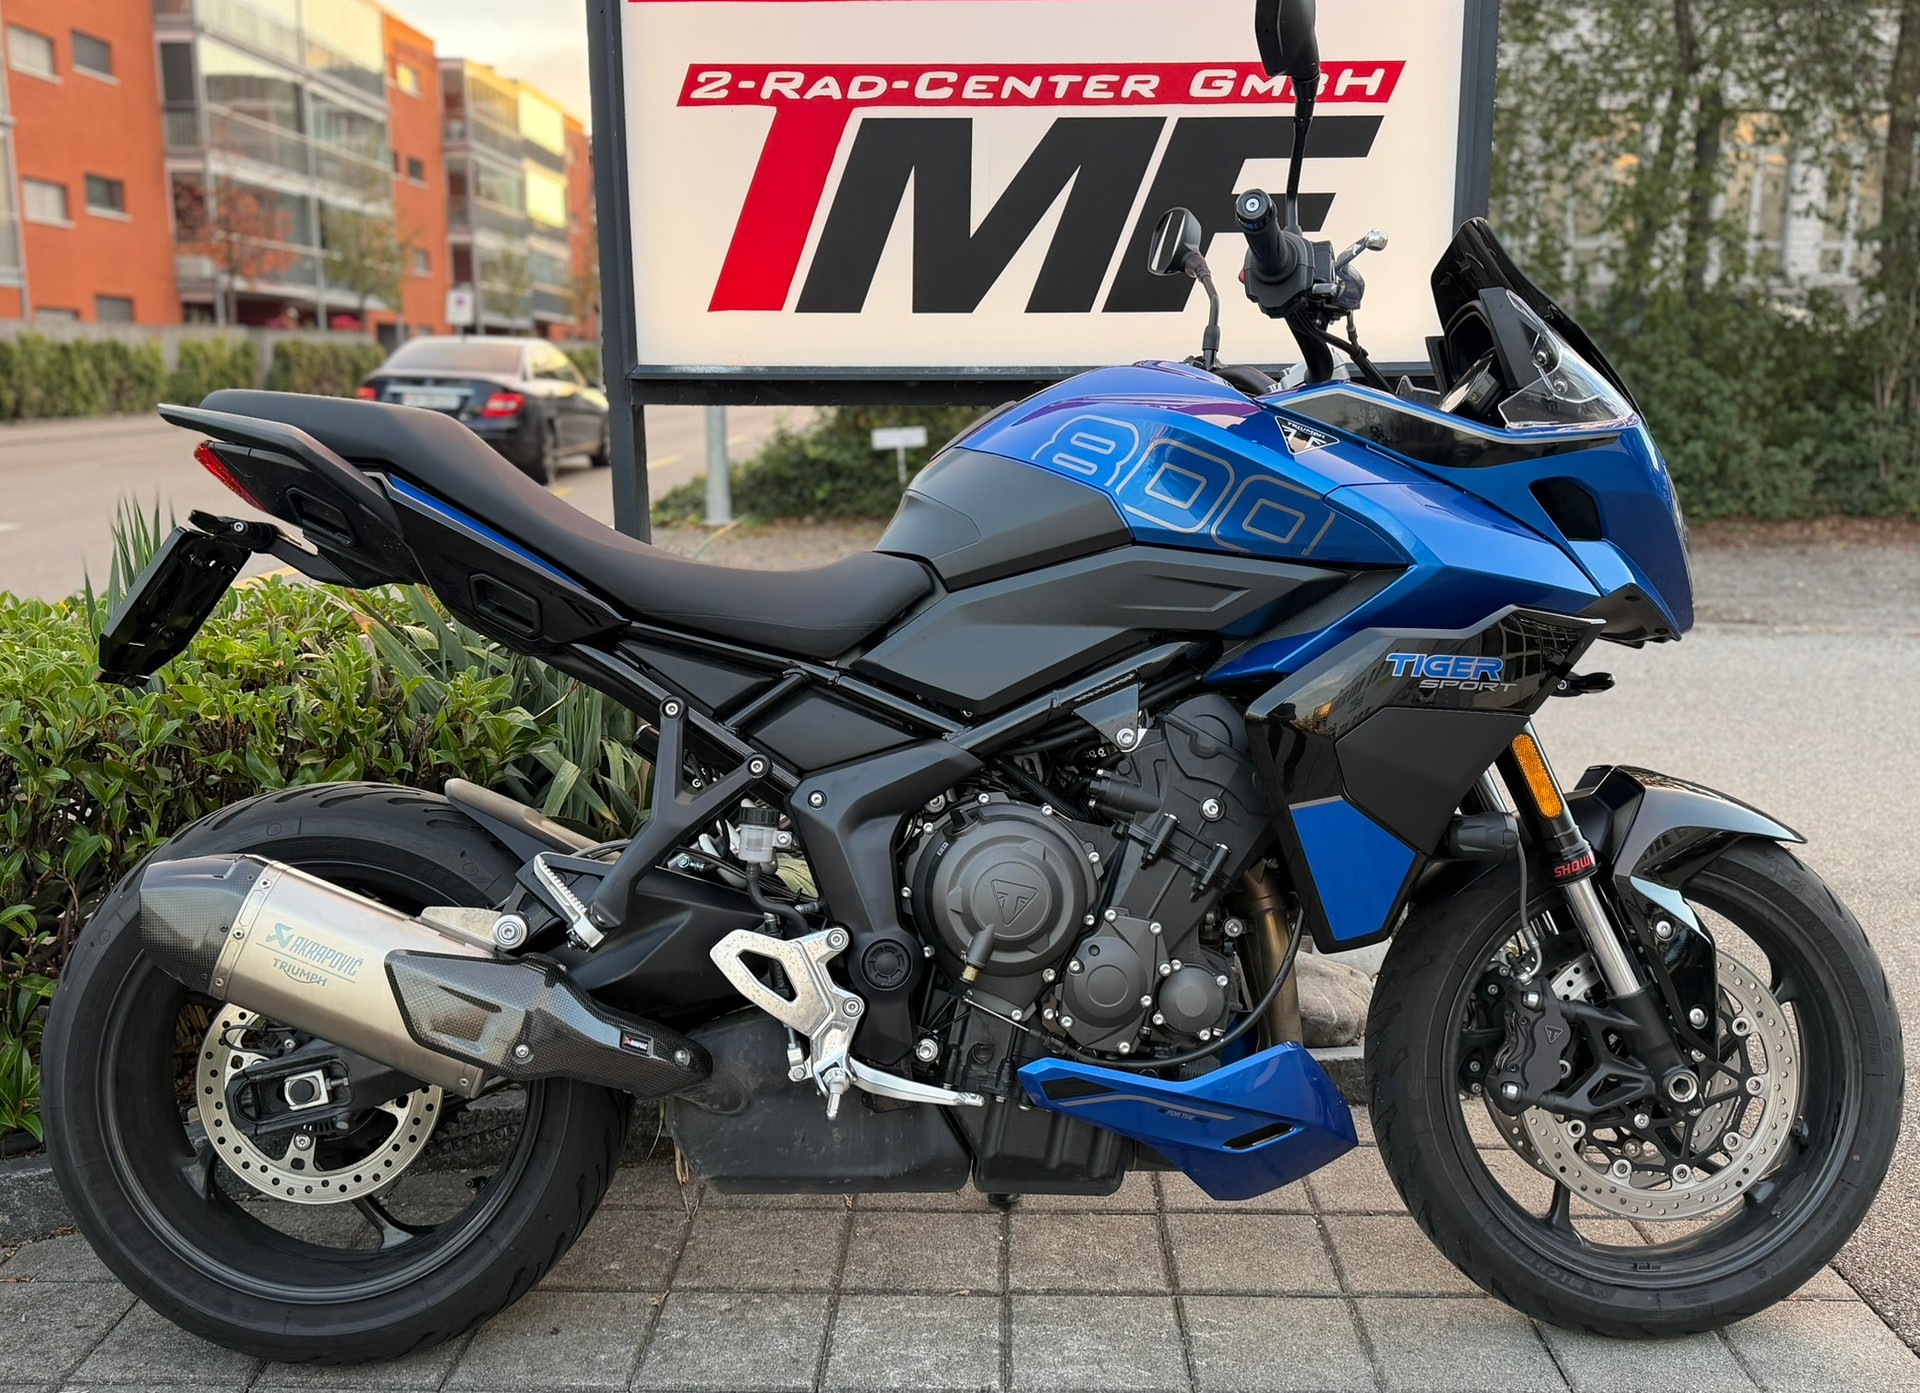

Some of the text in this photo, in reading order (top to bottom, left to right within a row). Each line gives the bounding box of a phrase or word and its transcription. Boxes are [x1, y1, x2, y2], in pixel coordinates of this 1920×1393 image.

[705, 98, 1385, 313] TMF
[1287, 420, 1326, 439] TRIUMPH
[1030, 413, 1336, 556] 800
[1386, 652, 1504, 682] TIGER
[1419, 679, 1518, 692] SPORT
[273, 957, 328, 987] TRIUMPH
